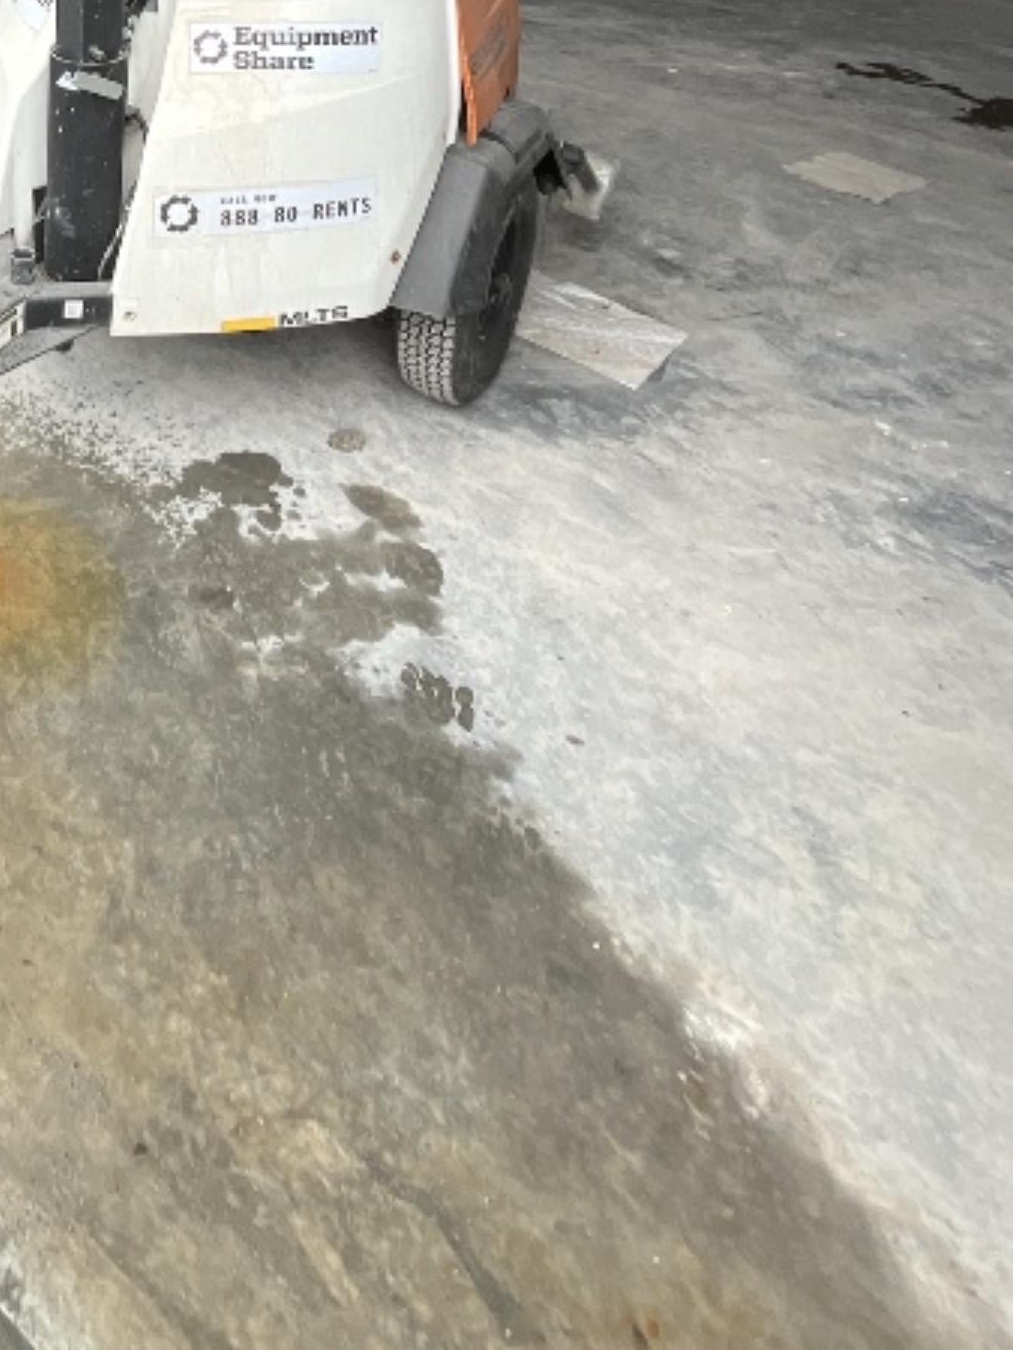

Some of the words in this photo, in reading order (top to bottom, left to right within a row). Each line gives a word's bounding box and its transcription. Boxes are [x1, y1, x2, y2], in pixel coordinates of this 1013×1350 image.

[233, 26, 378, 51] Equipment
[232, 51, 314, 70] Share
[313, 198, 372, 220] RENTS
